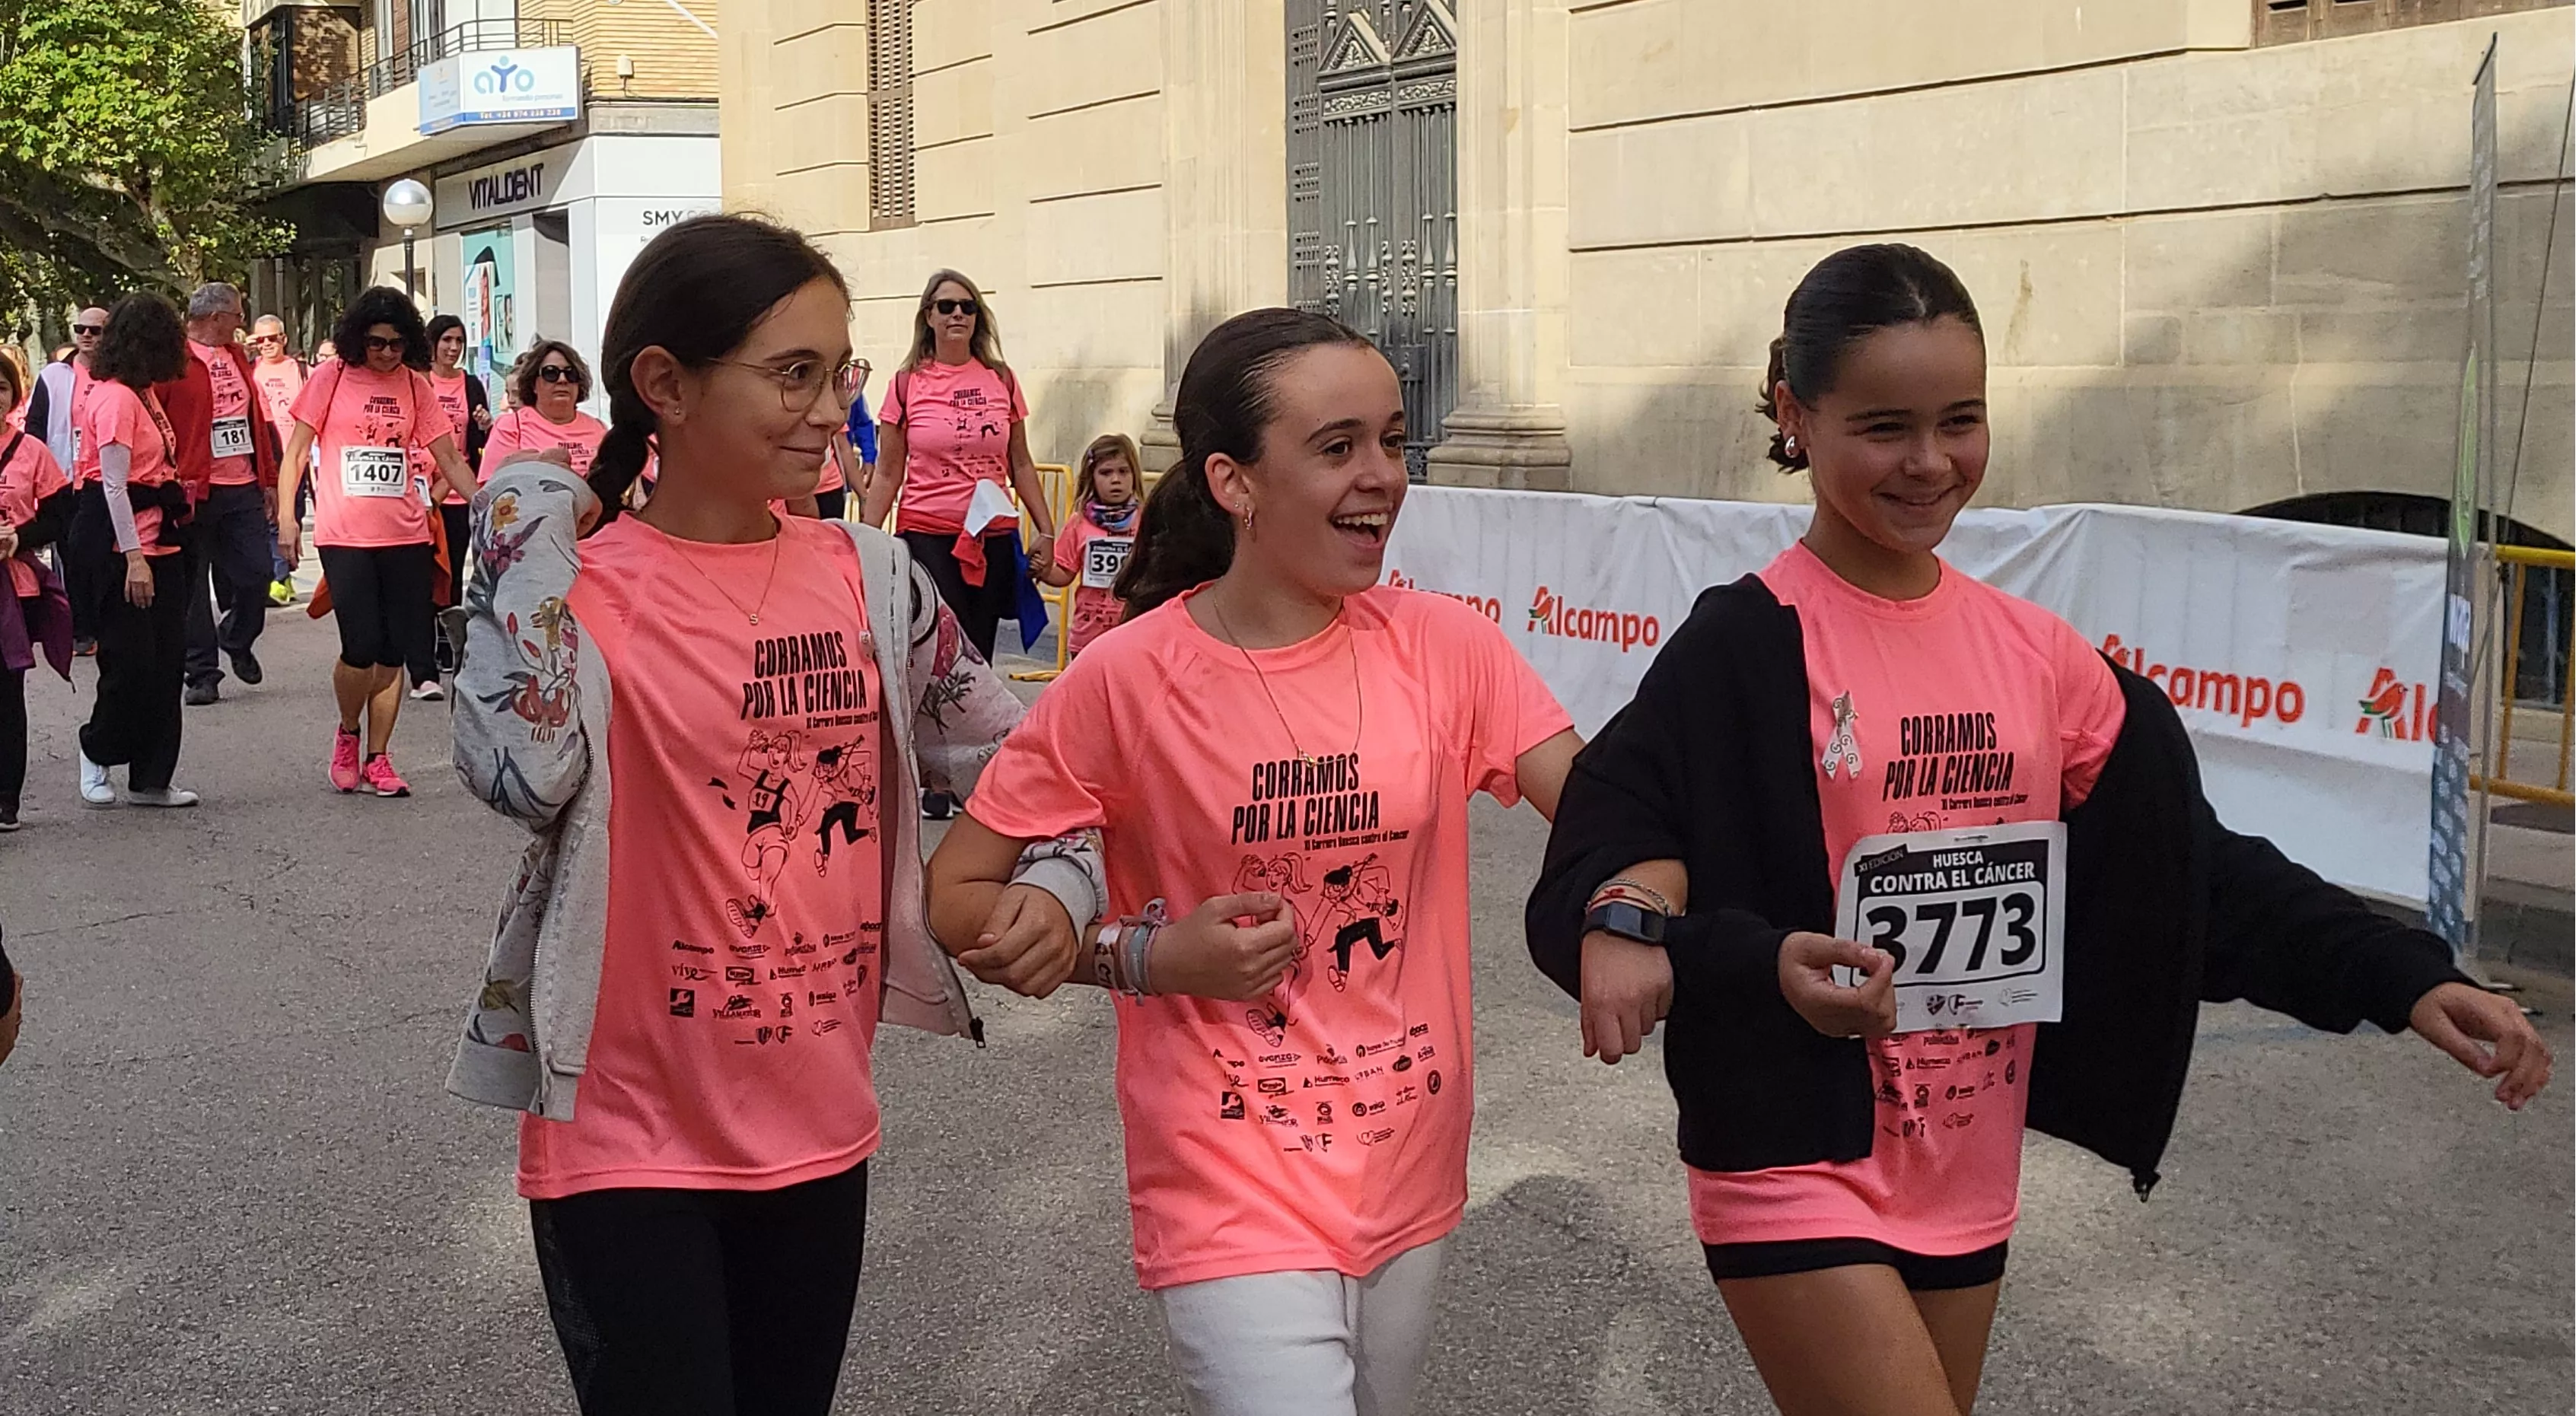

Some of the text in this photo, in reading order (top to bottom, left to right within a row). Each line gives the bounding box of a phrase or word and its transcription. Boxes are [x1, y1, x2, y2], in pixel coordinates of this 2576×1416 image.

[468, 163, 544, 210] VITALDENT
[221, 428, 246, 445] 181
[350, 464, 402, 483] 1407
[1527, 585, 1661, 653] Alcampo
[754, 630, 848, 679] CORRAMOS
[740, 669, 868, 721] POR LA CIENCIA
[1901, 712, 1997, 756] CORRAMOS
[1253, 752, 1359, 801] CORRAMOS
[1882, 752, 2015, 802] POR LA CIENCIA
[1231, 791, 1379, 845] POR LA CIENCIA
[1870, 861, 2036, 894] CONTRA EL CÁNCER
[1933, 851, 1984, 869] HUESCA
[1859, 892, 2036, 978] 3773
